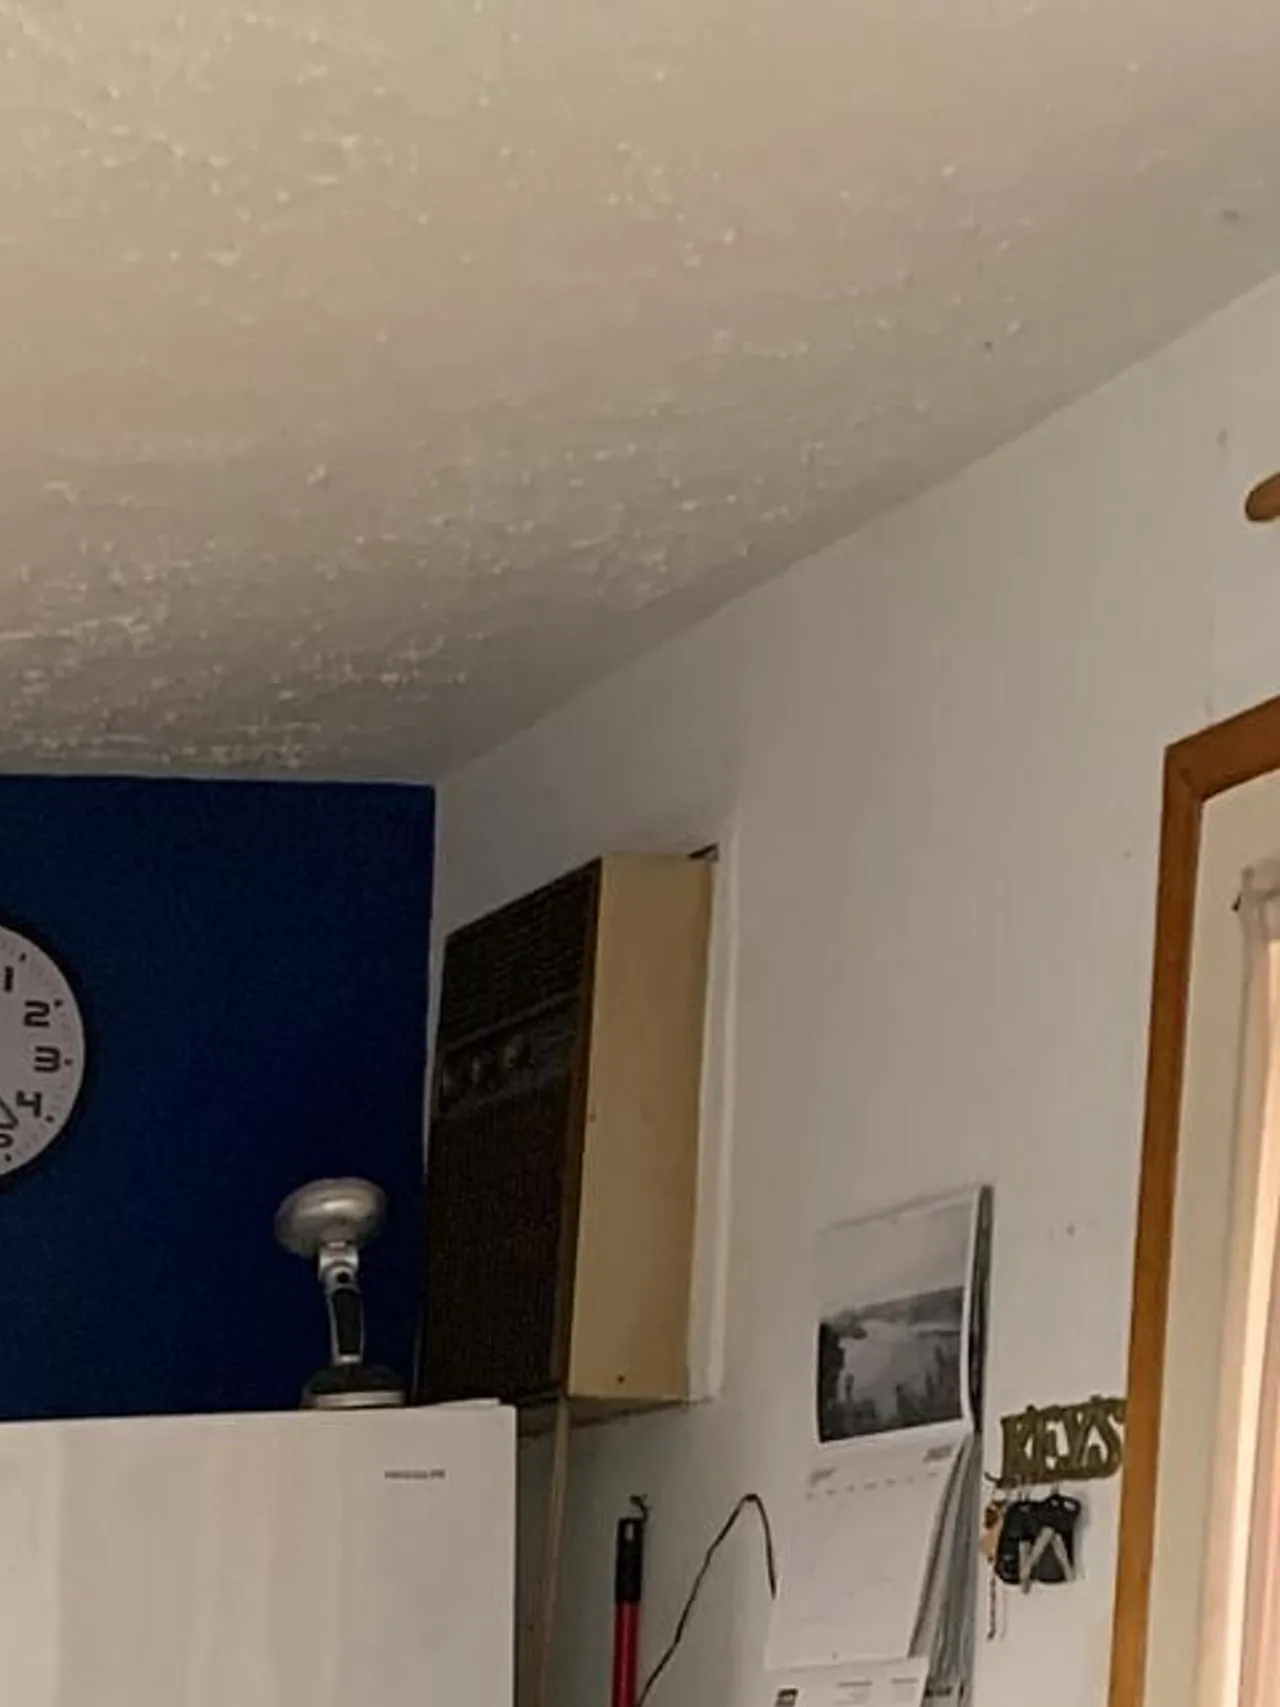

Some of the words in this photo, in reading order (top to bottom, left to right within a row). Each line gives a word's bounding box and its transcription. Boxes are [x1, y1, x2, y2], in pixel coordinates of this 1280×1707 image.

[4, 966, 14, 993] 1
[24, 1001, 50, 1027] 2
[34, 1046, 61, 1073] 3
[16, 1090, 42, 1117] 4
[1001, 1395, 1126, 1487] KEYS
